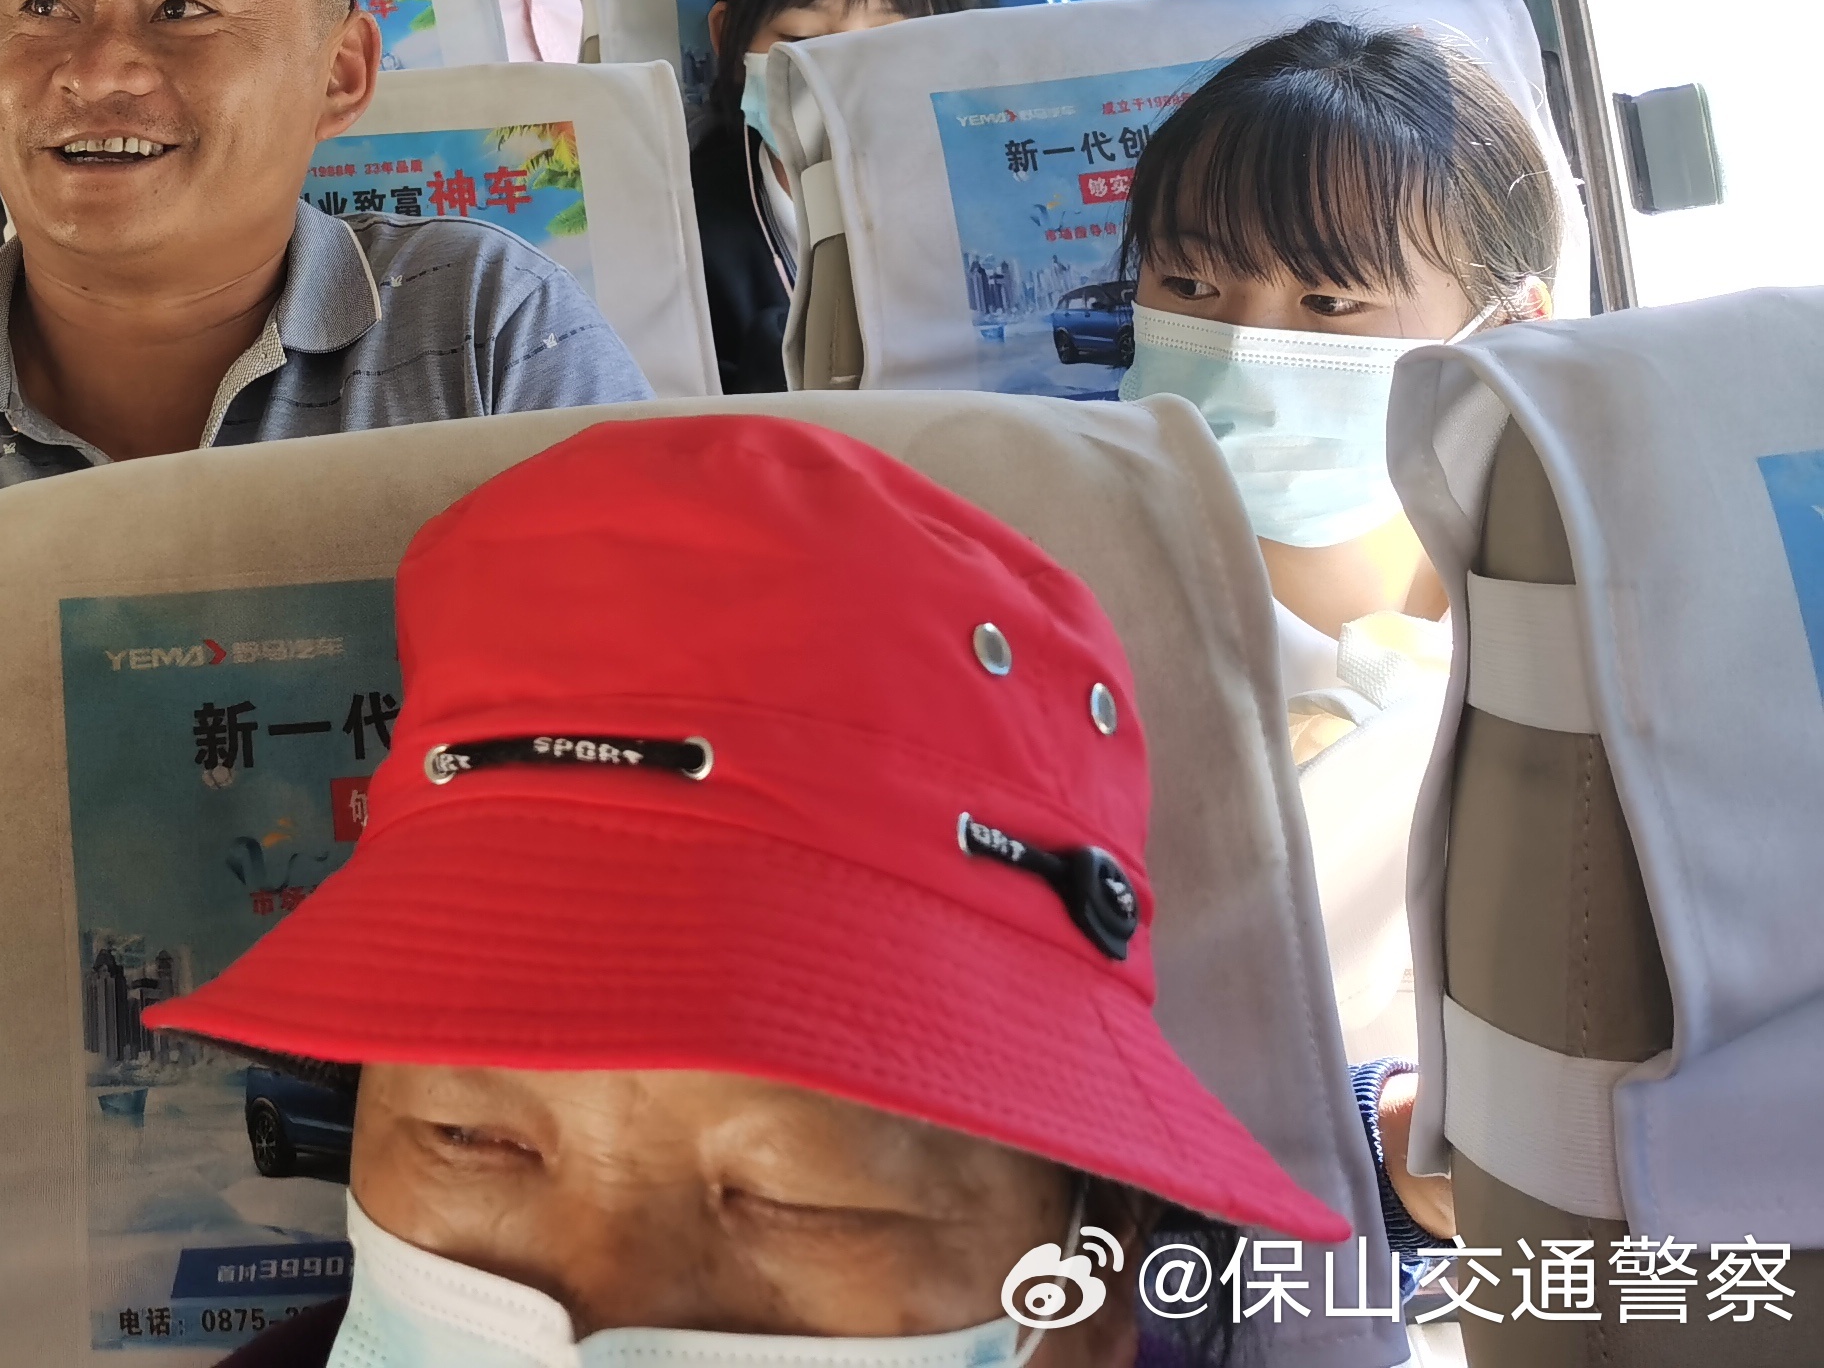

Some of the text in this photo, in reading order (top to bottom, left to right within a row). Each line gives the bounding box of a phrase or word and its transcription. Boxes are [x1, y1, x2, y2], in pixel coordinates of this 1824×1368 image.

[1004, 123, 1150, 174] 新一代创
[307, 163, 357, 178] 1988年
[301, 166, 532, 218] 业致富神车
[105, 644, 205, 671] YEMA
[193, 691, 401, 769] 新一代
[532, 735, 644, 767] SPORT
